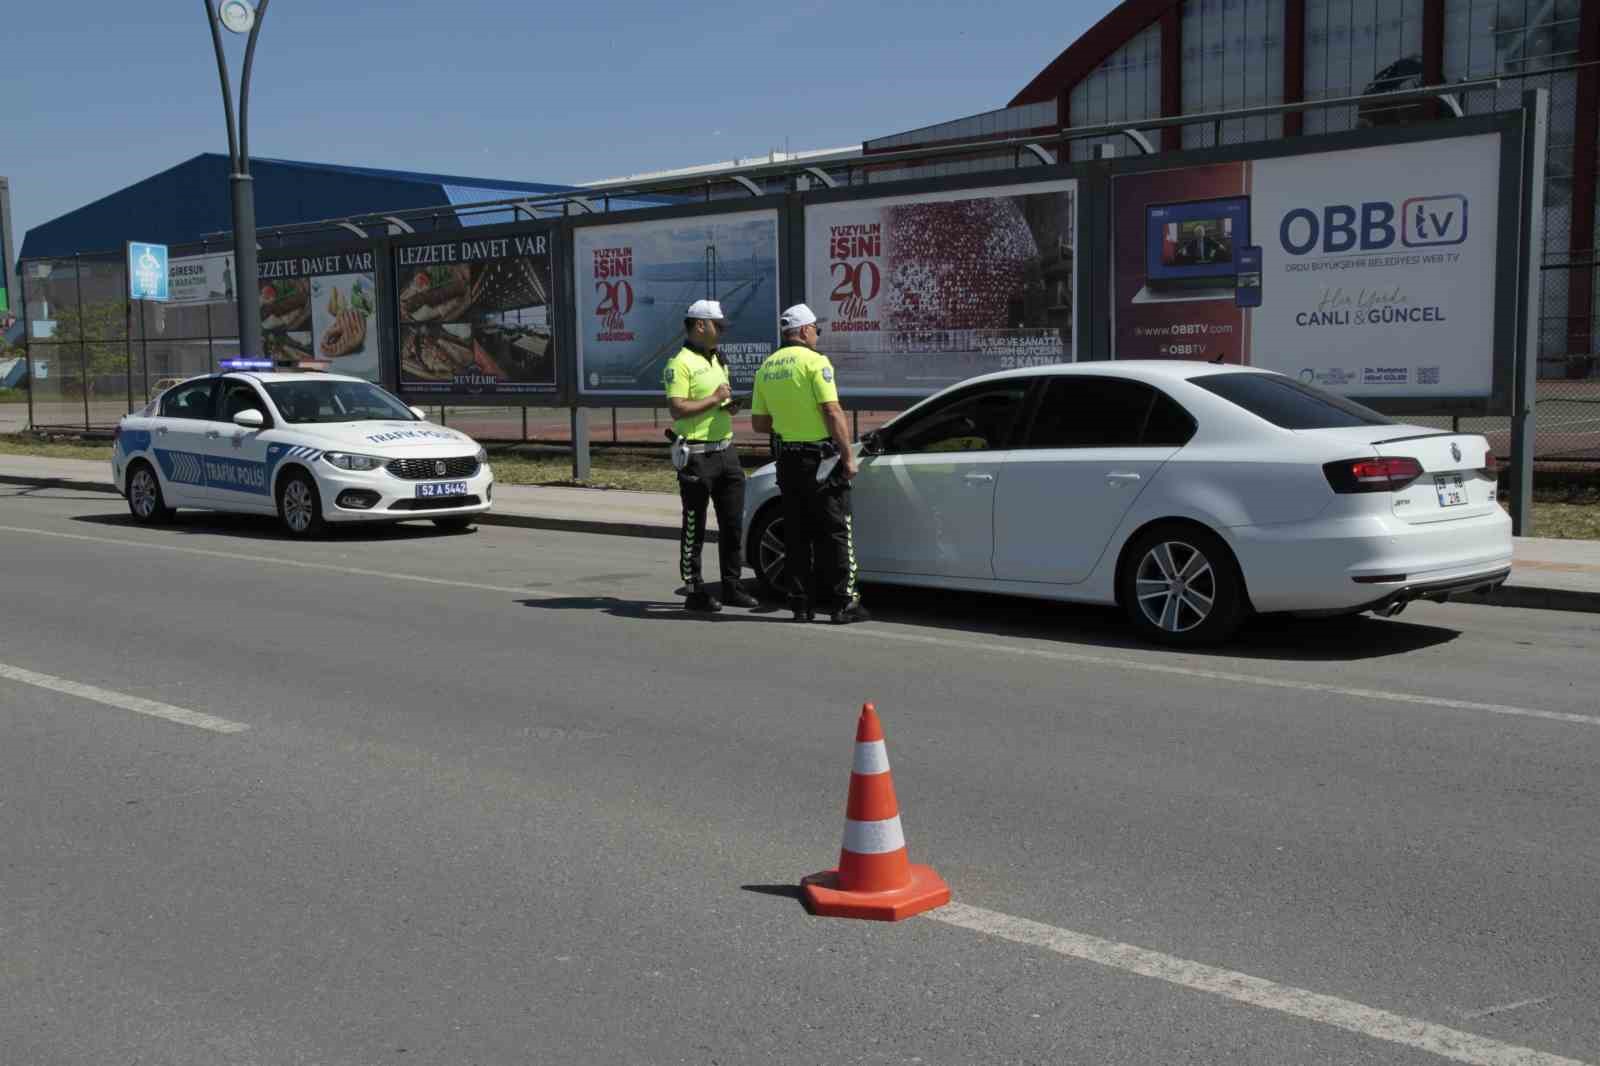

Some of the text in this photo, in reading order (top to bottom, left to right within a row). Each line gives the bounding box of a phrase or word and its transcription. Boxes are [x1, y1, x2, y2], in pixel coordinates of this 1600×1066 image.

[1279, 201, 1396, 255] OBB
[400, 236, 547, 265] LEZZETE DAVET VAR
[1422, 254, 1444, 264] WEB
[256, 252, 373, 278] EZZETE DAVET VAR
[830, 261, 881, 302] 20
[595, 280, 634, 317] 20
[1295, 310, 1350, 328] CANLI
[1367, 305, 1446, 324] GÜNCEL
[1145, 323, 1233, 336] www.OBBTV.com
[1168, 344, 1207, 354] OBBTV
[422, 484, 467, 496] 52 A 5442
